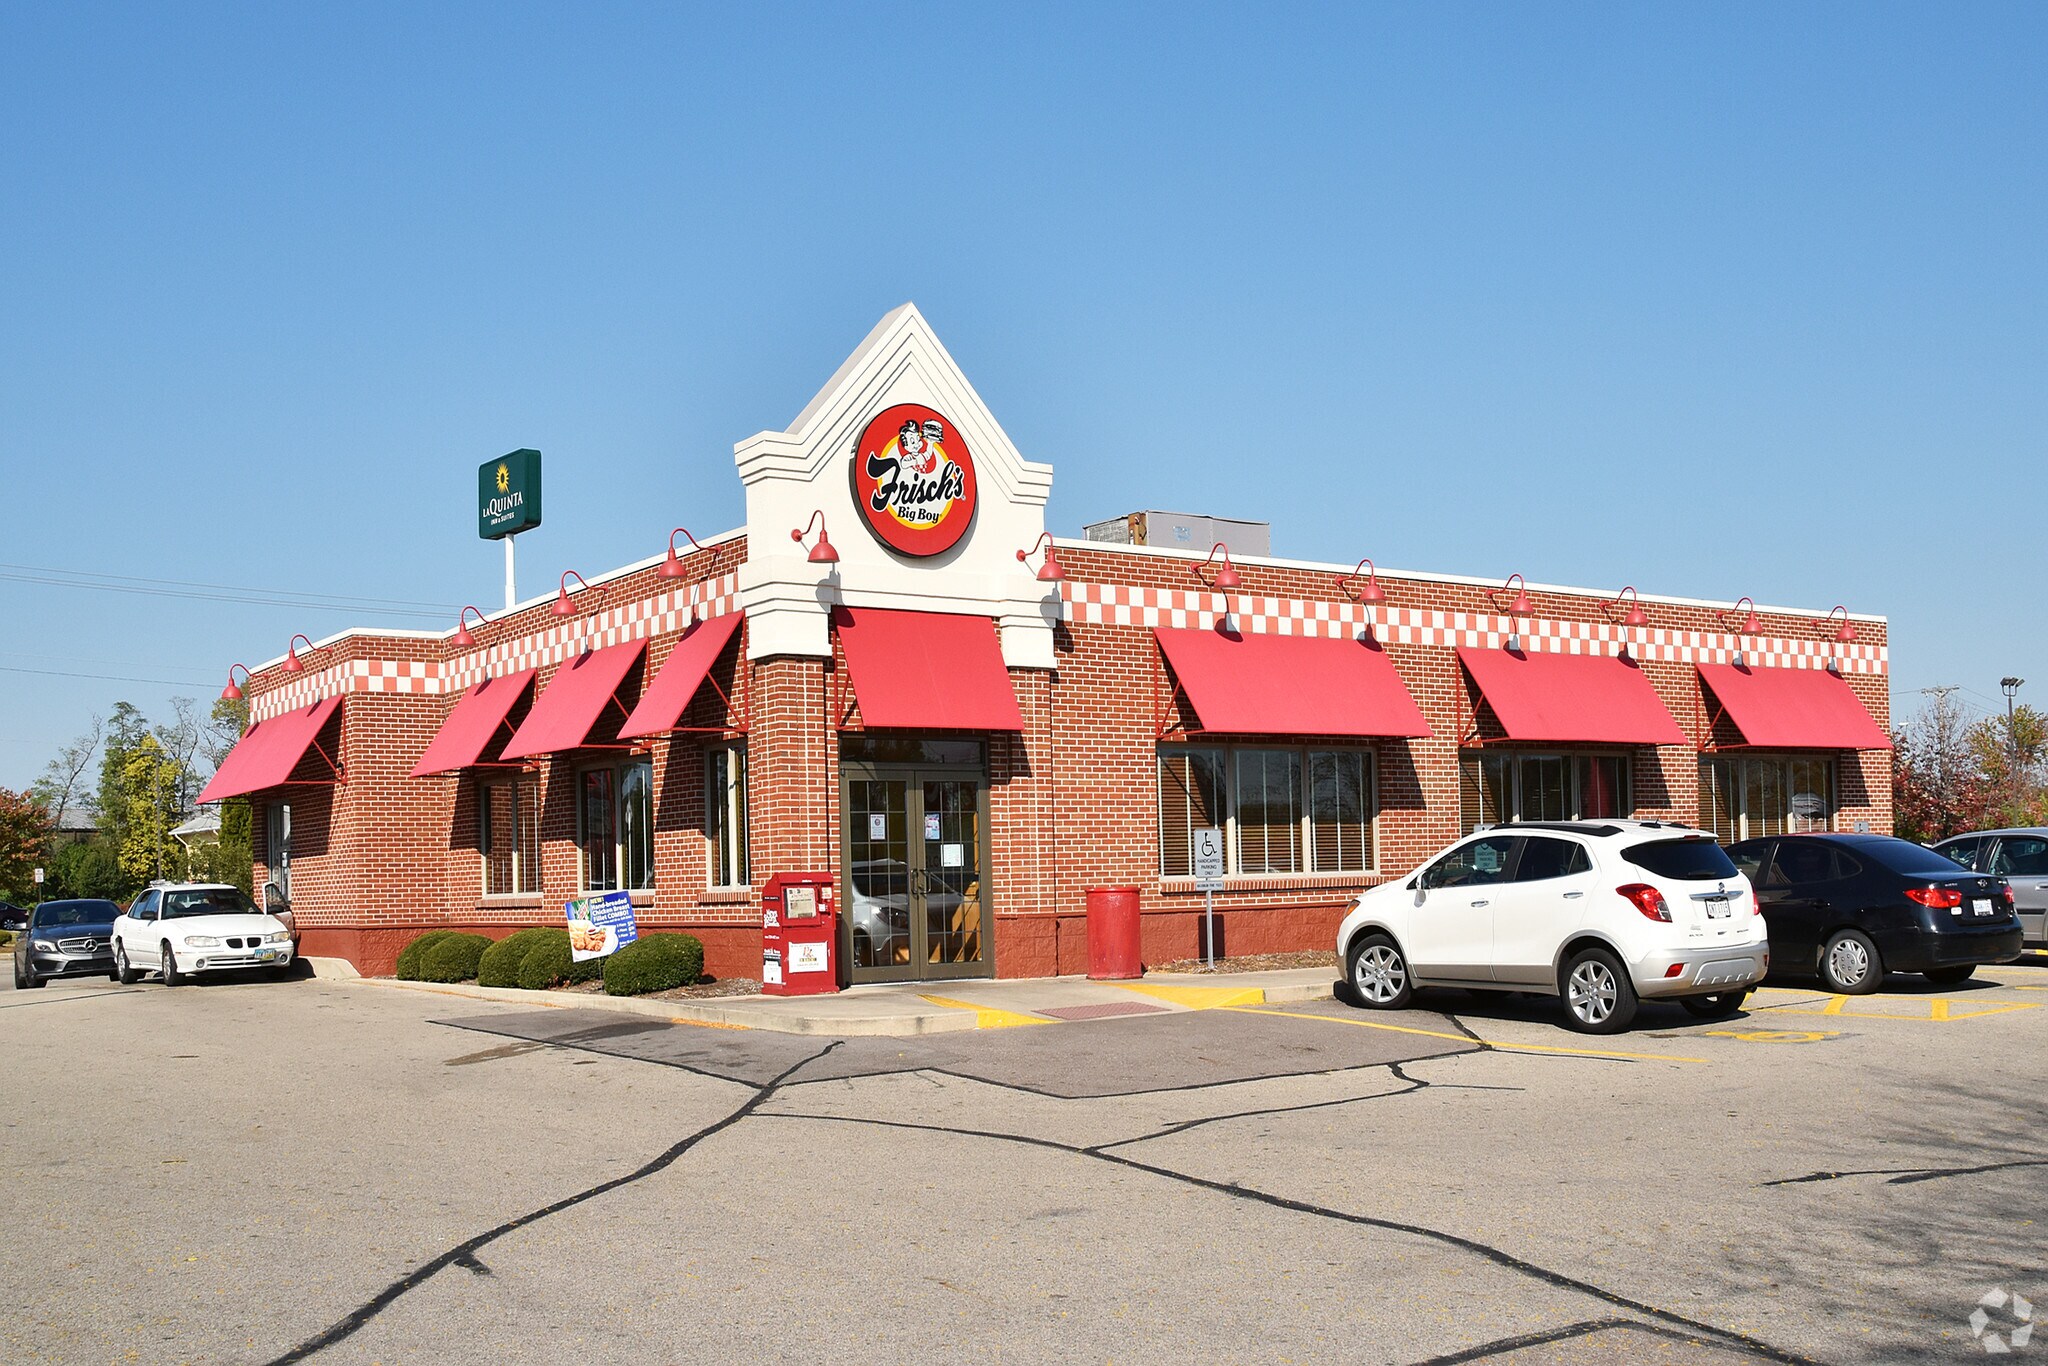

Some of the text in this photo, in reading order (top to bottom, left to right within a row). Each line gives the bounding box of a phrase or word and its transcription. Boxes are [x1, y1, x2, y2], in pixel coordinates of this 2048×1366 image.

[867, 453, 964, 511] Frisch's
[489, 491, 523, 517] QUINTA
[897, 506, 939, 524] Big Boy
